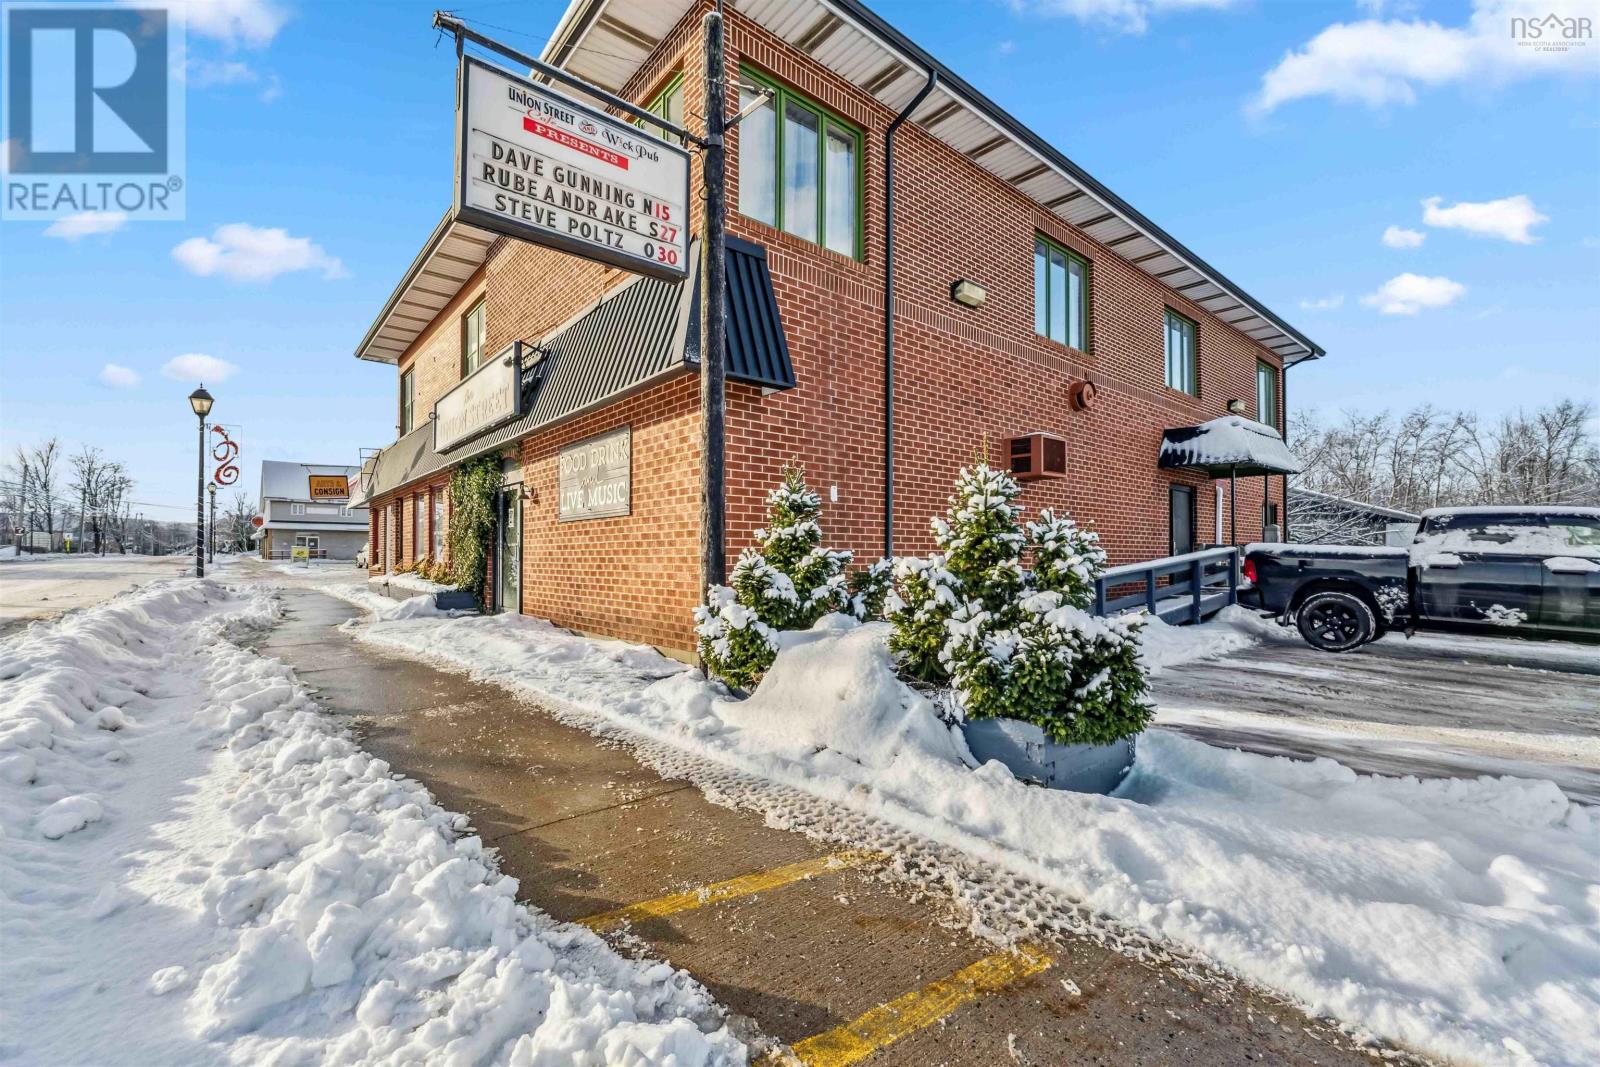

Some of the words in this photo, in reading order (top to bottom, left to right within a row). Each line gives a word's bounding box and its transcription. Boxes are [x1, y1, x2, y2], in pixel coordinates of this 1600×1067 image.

[508, 87, 541, 111] UNION
[544, 104, 574, 126] STREET
[535, 123, 619, 164] PRESENTS
[635, 144, 659, 162] Pub
[491, 141, 544, 176] DAVE
[553, 166, 635, 209] GUNNING
[494, 193, 556, 228] STEVE
[567, 217, 624, 249] POLTZ
[560, 452, 587, 475] FOOD
[590, 439, 629, 467] DRINK
[314, 488, 345, 496] CONSIGN
[561, 490, 584, 511] LIVE
[588, 481, 627, 507] MUSIC
